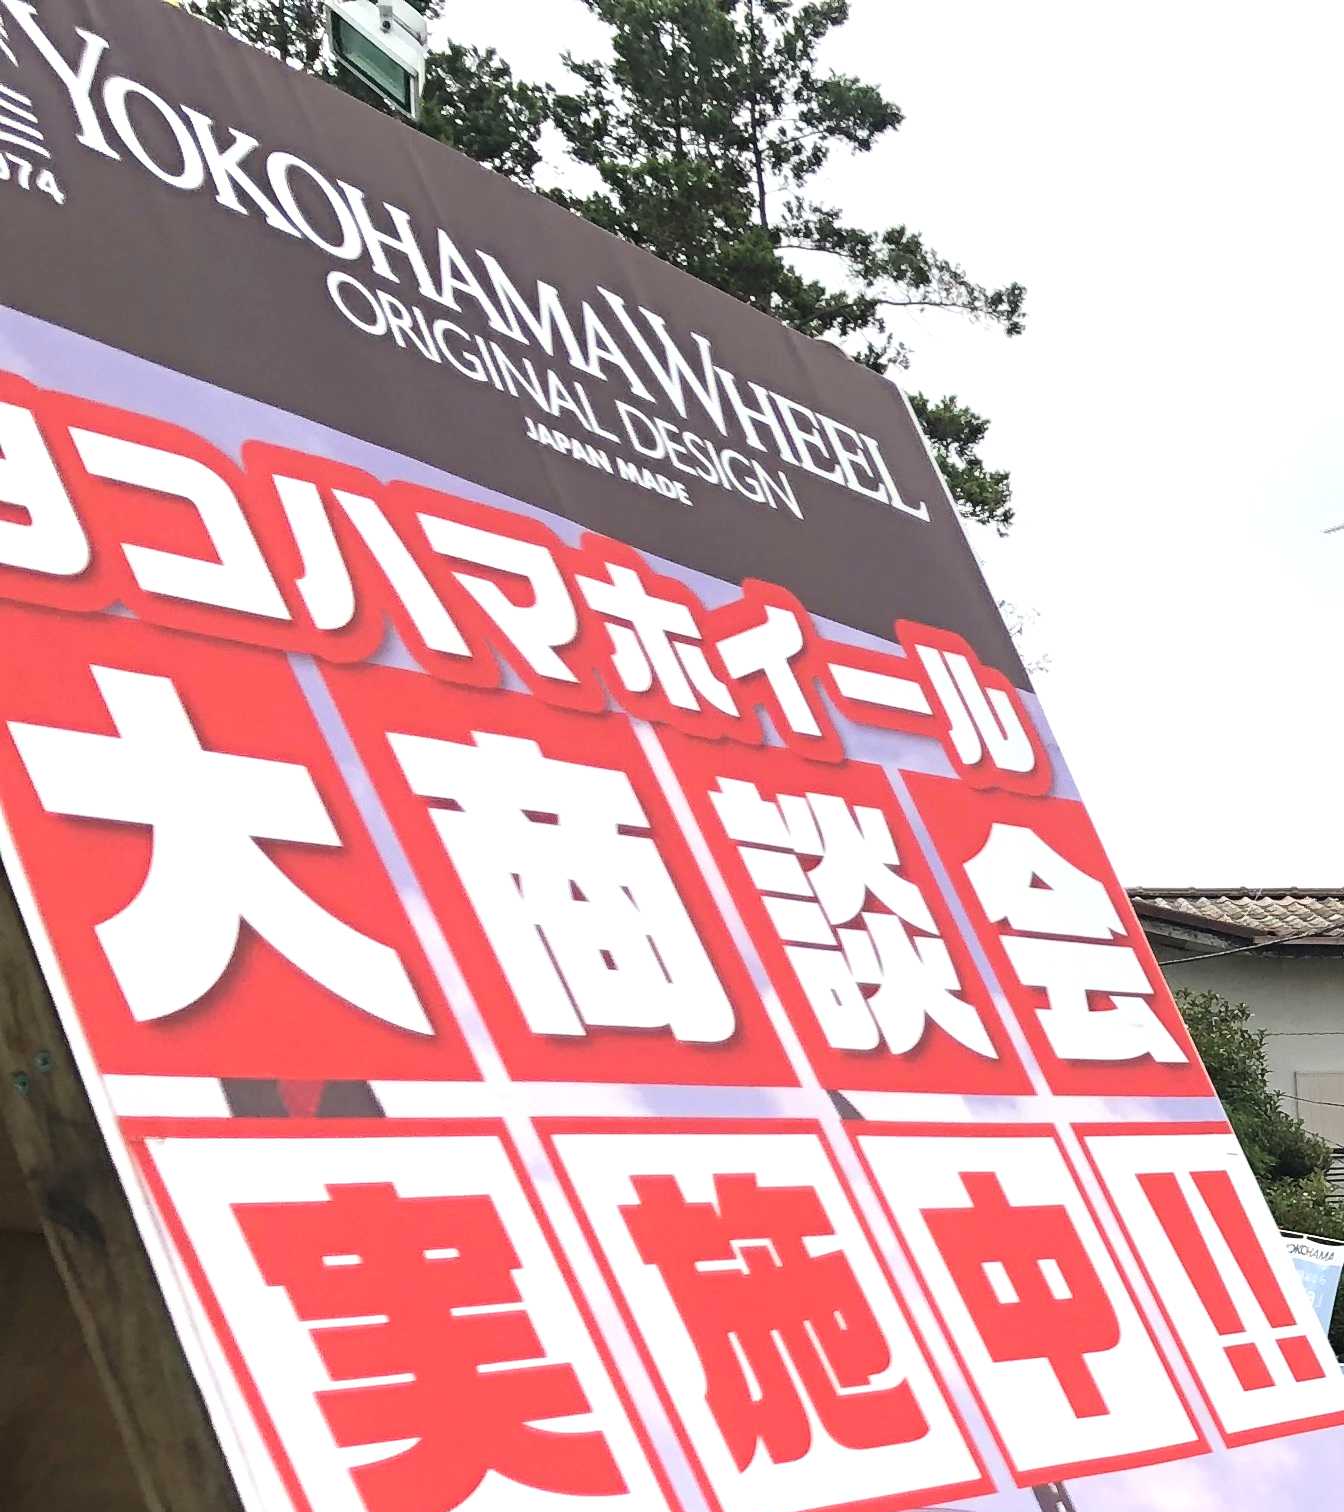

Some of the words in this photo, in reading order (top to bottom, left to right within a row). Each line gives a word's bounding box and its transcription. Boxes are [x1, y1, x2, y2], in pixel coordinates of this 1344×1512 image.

[326, 270, 607, 440] ORIGINAL
[614, 398, 804, 521] DESIGN
[525, 416, 612, 476] JAPAN
[618, 462, 694, 507] MADE
[8, 664, 1190, 1065] 大商談会
